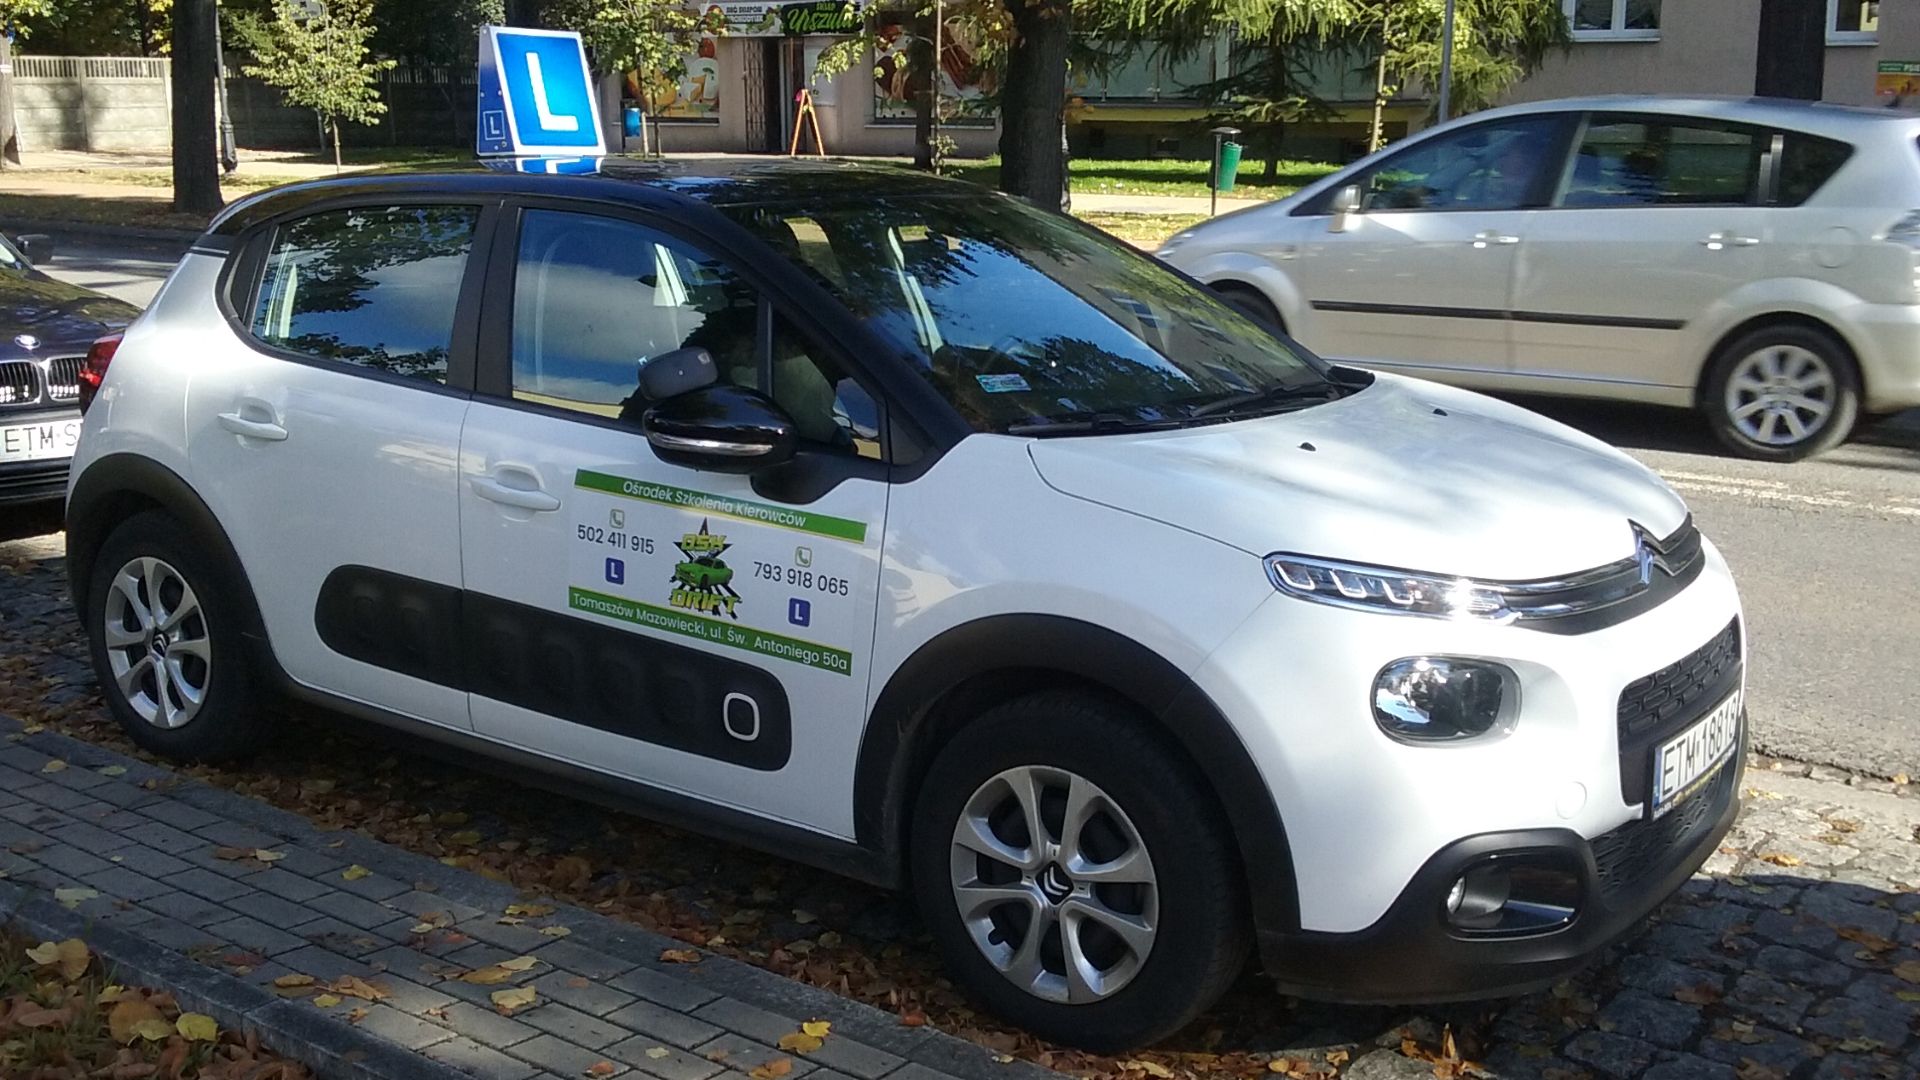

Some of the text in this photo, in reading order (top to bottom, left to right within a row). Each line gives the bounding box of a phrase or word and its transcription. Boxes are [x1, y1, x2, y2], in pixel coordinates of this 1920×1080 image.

[525, 52, 579, 132] L
[490, 116, 500, 134] L
[4, 426, 54, 453] ETM
[623, 480, 806, 527] Ośrodek Szkolenia Kierowców
[577, 524, 654, 555] 502 411 915
[681, 533, 727, 551] OSK
[611, 562, 618, 578] L
[754, 561, 849, 596] 793 918 065
[670, 588, 741, 614] DRIFT
[794, 603, 803, 620] L
[573, 592, 633, 618] Tomaszów
[636, 608, 708, 637] Mazowiecki,
[754, 636, 820, 664] Antoniego
[823, 652, 847, 670] 50a
[1663, 729, 1697, 796] ETM
